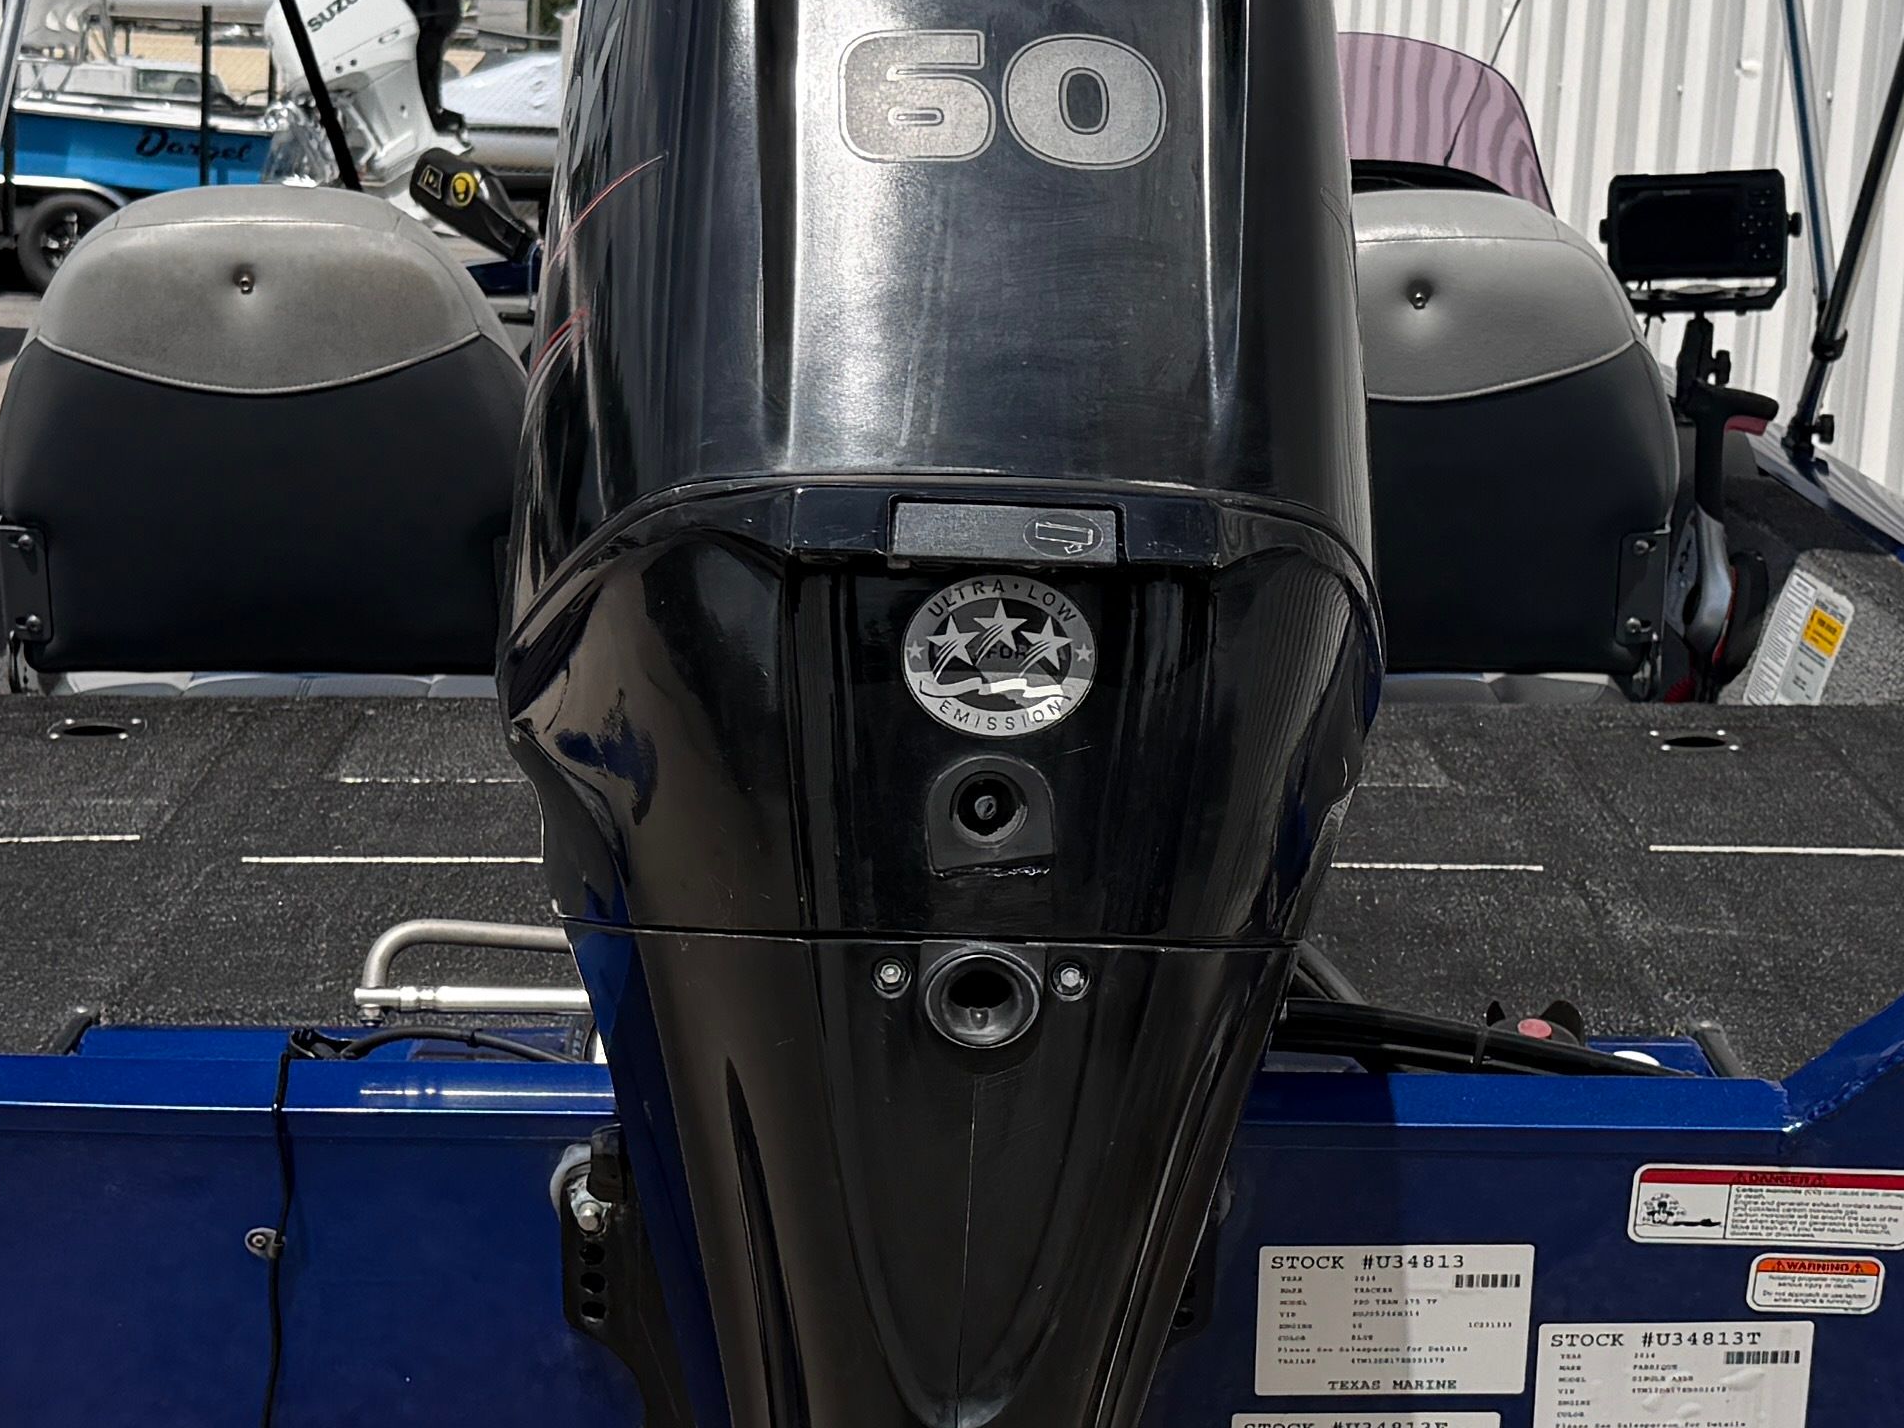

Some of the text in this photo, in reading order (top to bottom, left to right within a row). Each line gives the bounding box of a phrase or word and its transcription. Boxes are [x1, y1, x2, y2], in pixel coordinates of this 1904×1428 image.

[837, 29, 1167, 171] 60
[928, 578, 1078, 622] ULTRA LOW
[937, 695, 1070, 731] EMISSION
[1271, 1254, 1465, 1270] STOCK #U34813
[1786, 1261, 1849, 1272] WARNING
[1550, 1332, 1762, 1348] STOCK #U34813T
[1328, 1379, 1458, 1391] TEXAS MARINE
